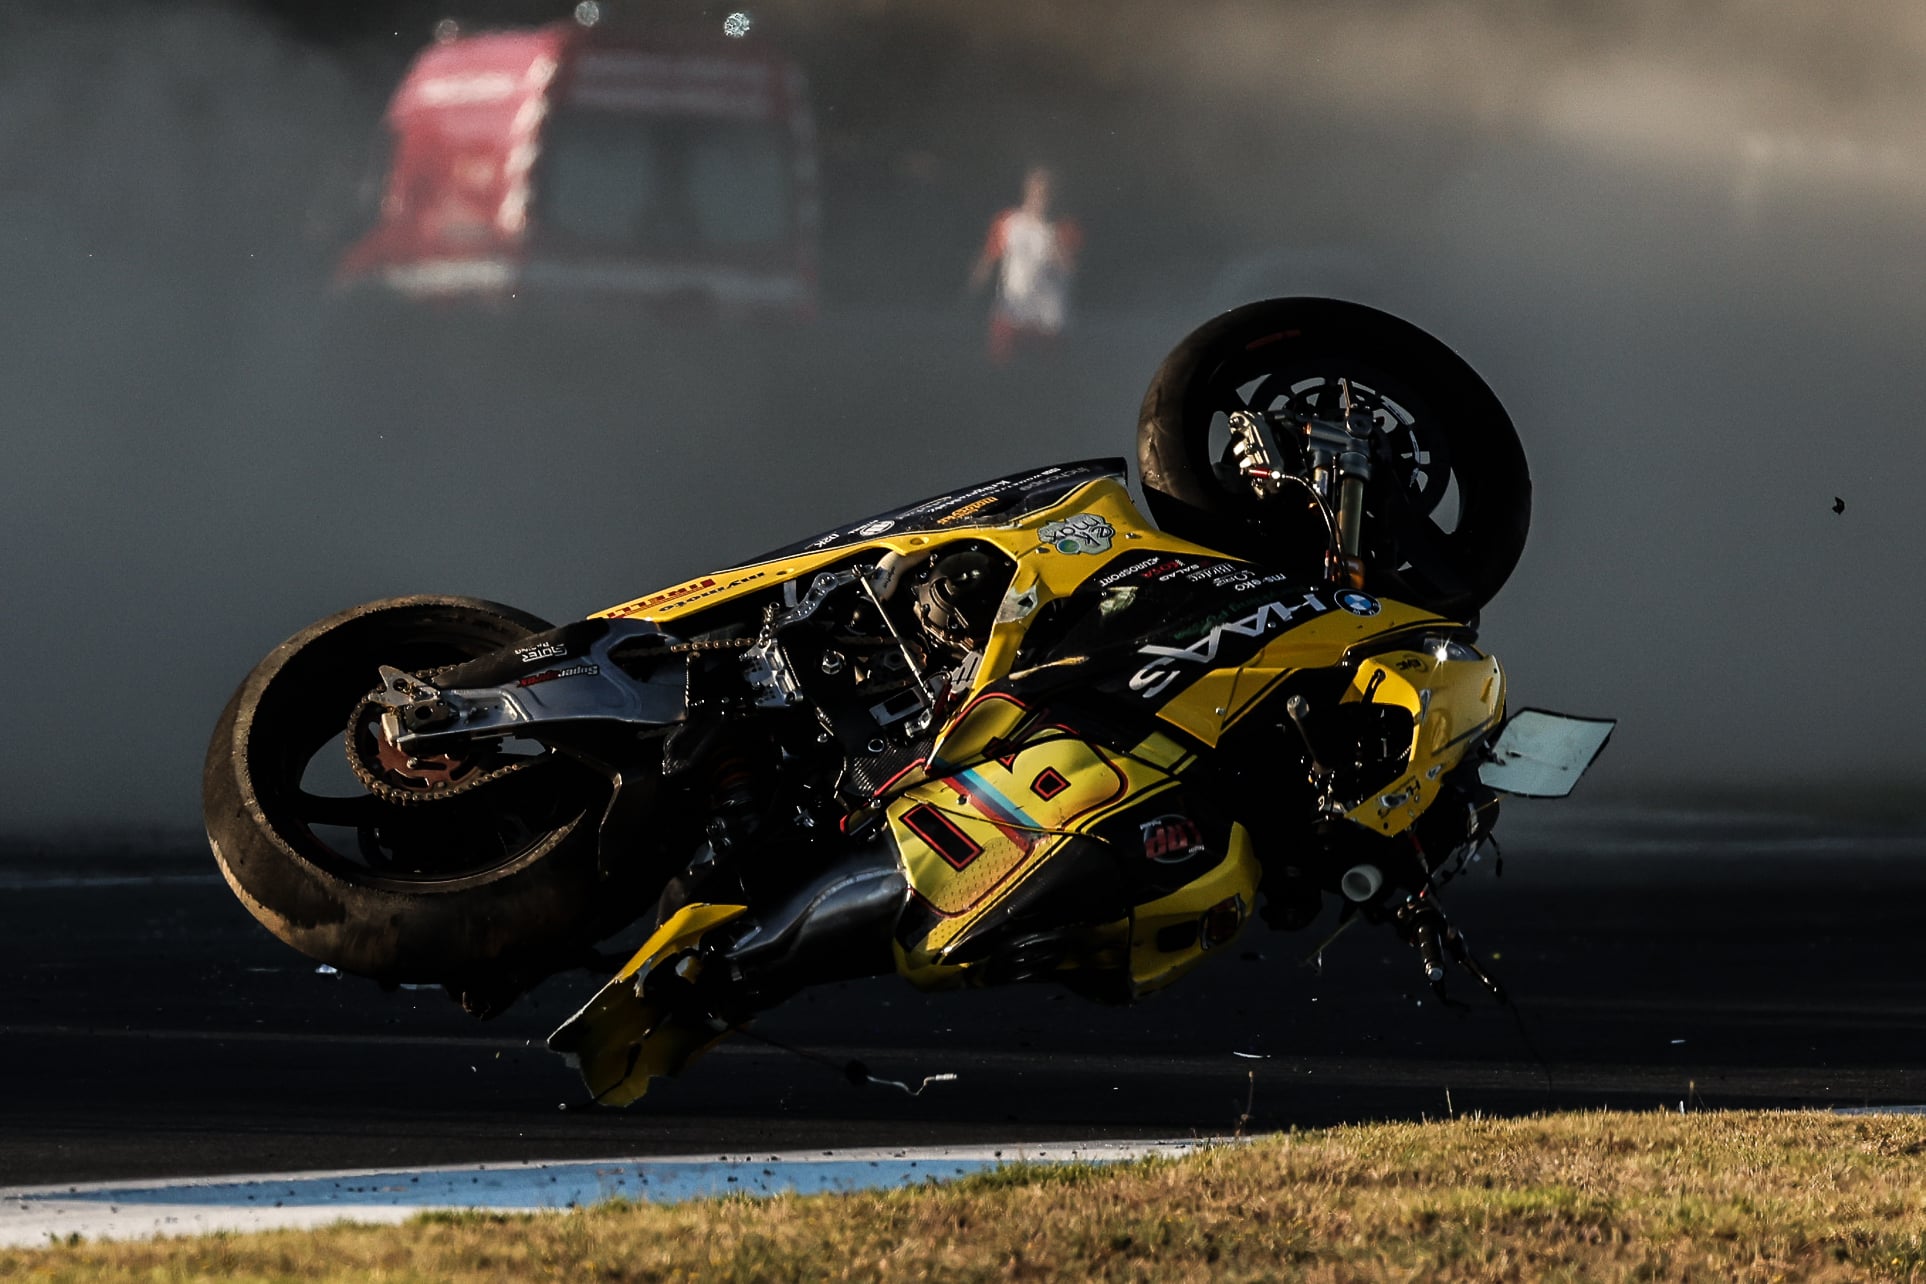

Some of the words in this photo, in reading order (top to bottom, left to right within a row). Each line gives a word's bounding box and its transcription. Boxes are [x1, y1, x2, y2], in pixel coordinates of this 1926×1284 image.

[1100, 557, 1158, 586] EUROSPORT
[605, 579, 717, 619] PIRELLI
[658, 572, 765, 612] mymoto
[1129, 593, 1329, 699] HAAS
